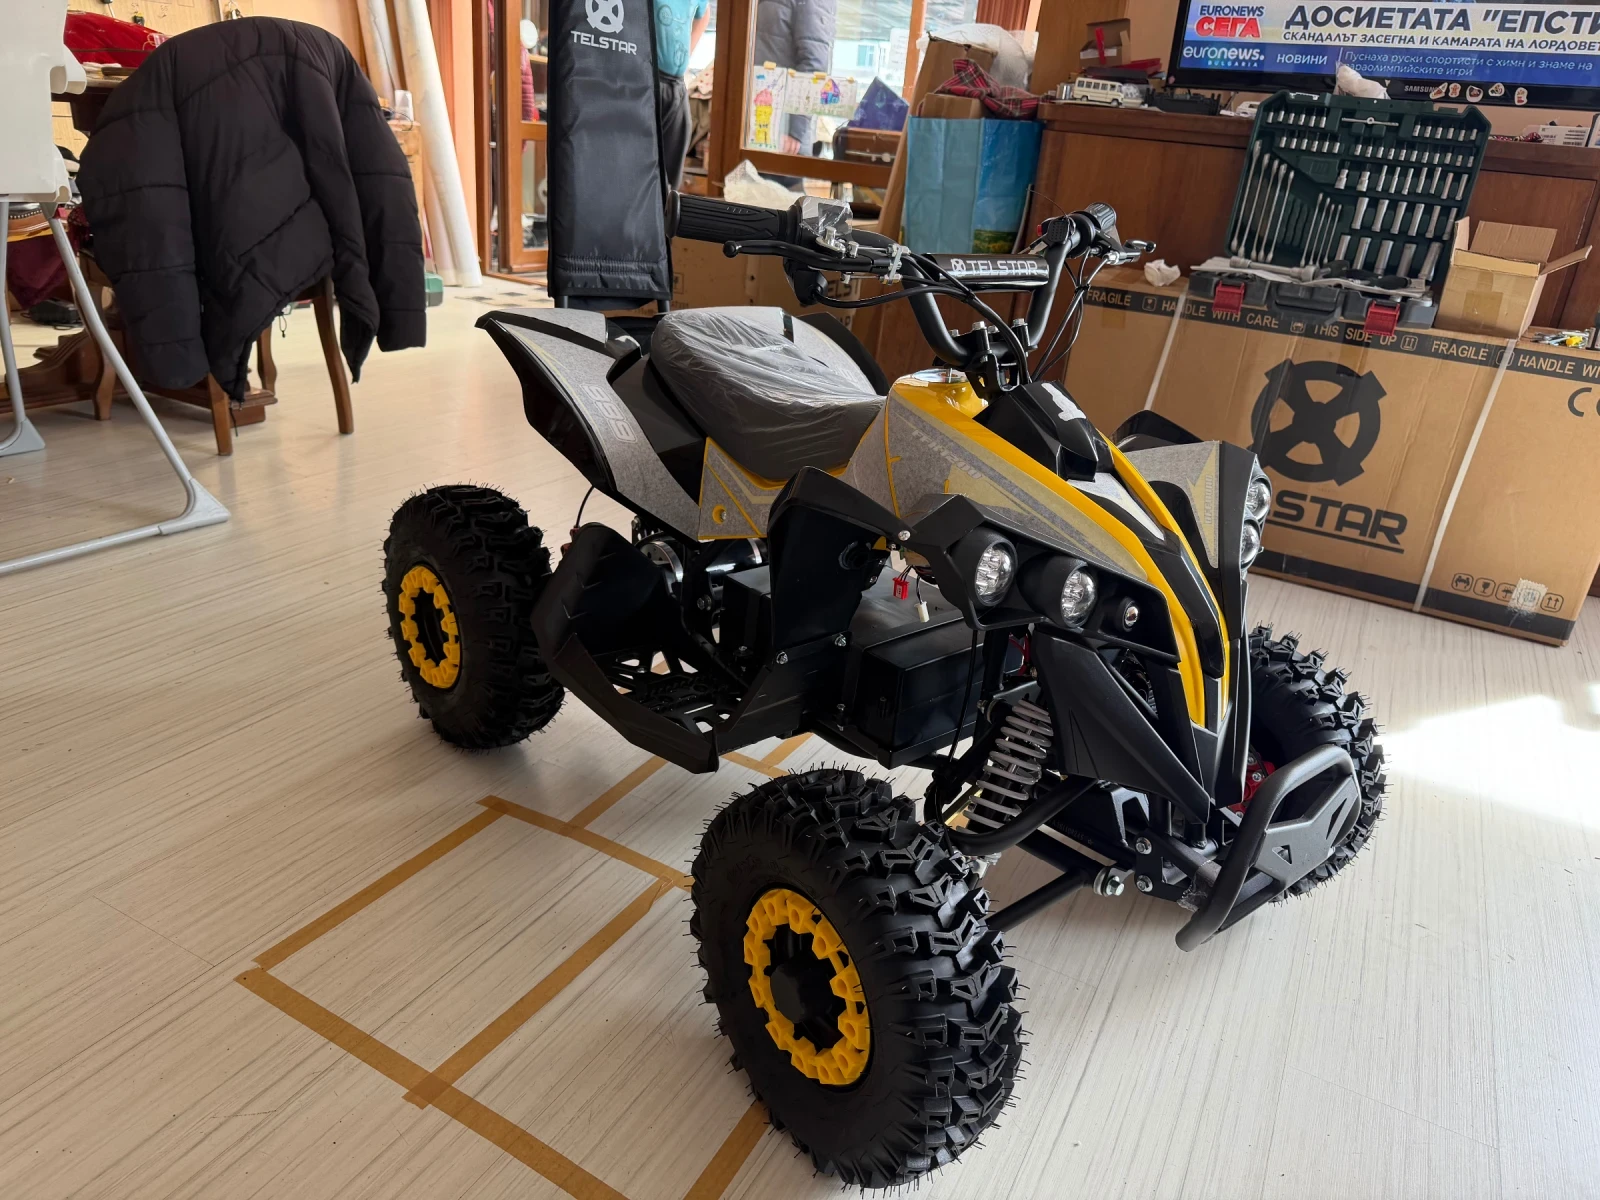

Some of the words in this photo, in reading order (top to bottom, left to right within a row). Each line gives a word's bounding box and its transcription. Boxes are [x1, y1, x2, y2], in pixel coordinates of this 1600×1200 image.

[1200, 5, 1265, 17] EURONEWS
[1284, 5, 1471, 31] ДОСИЕТАТА
[1195, 16, 1261, 38] СЕГА
[570, 30, 637, 55] TELSTAR
[1283, 31, 1357, 43] СКАНДАЛЪТ
[1360, 33, 1418, 44] ЗАСЕГНА
[1419, 36, 1430, 45] И
[1432, 36, 1500, 47] КАМАРАТА
[1505, 38, 1525, 48] НА
[1276, 53, 1328, 65] НОВИНИ
[1345, 51, 1388, 63] Пуснаха
[1390, 54, 1423, 63] руски
[1426, 55, 1484, 66] спортисти
[1486, 58, 1494, 66] с
[1496, 59, 1525, 67] химн
[1538, 61, 1575, 70] знаме
[1578, 63, 1593, 71] на
[1446, 66, 1473, 76] игри
[966, 260, 1038, 276] TELSTAR
[1086, 289, 1132, 306] FRAGILE
[1161, 300, 1207, 317] HADLE
[1246, 313, 1279, 328] CARE
[1345, 327, 1373, 343] SIDE
[1379, 334, 1397, 346] UP
[1431, 340, 1489, 361] FRAGILE
[1517, 354, 1576, 375] HANDLE
[1268, 489, 1407, 545] STAR
